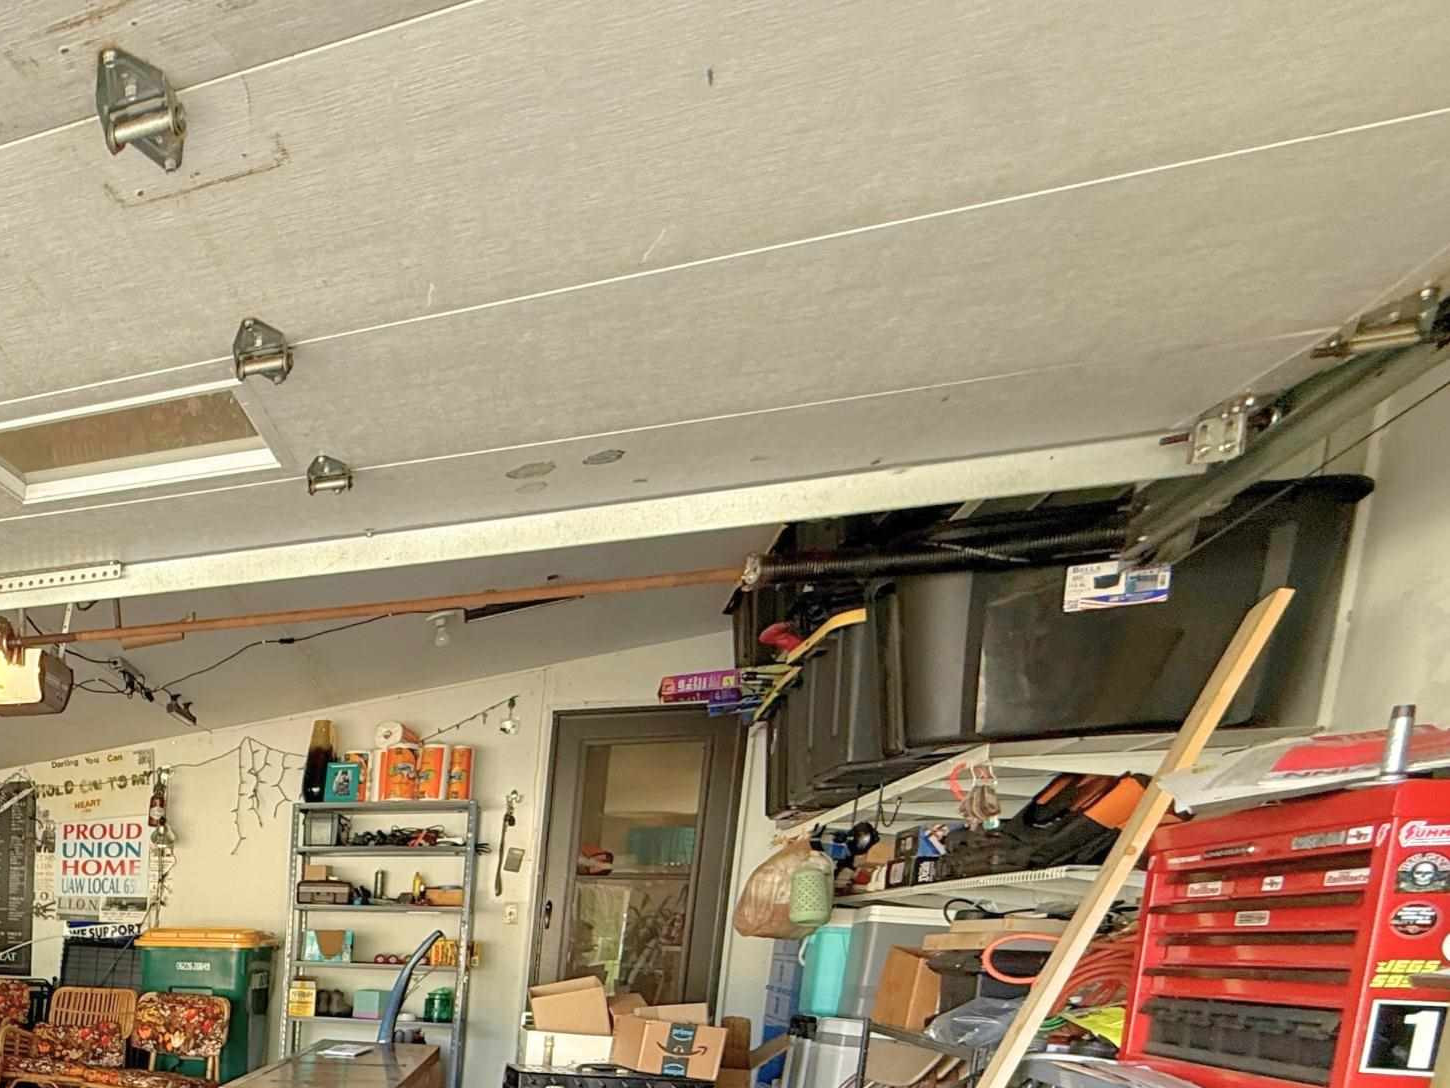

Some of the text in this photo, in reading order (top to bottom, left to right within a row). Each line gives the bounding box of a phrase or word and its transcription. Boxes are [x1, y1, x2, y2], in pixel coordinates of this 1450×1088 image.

[51, 754, 123, 768] Darling You Can
[36, 780, 74, 798] HOLD
[108, 775, 128, 791] TO
[74, 799, 101, 808] HEART
[63, 823, 143, 840] PROUD
[62, 841, 142, 858] UNION
[61, 859, 142, 876] HOME
[61, 878, 85, 894] UAW
[87, 878, 122, 894] LOCAL
[57, 897, 99, 911] LION
[89, 923, 142, 938] SUPPORT
[1375, 960, 1441, 973] JEGS
[1404, 1010, 1440, 1069] 1
